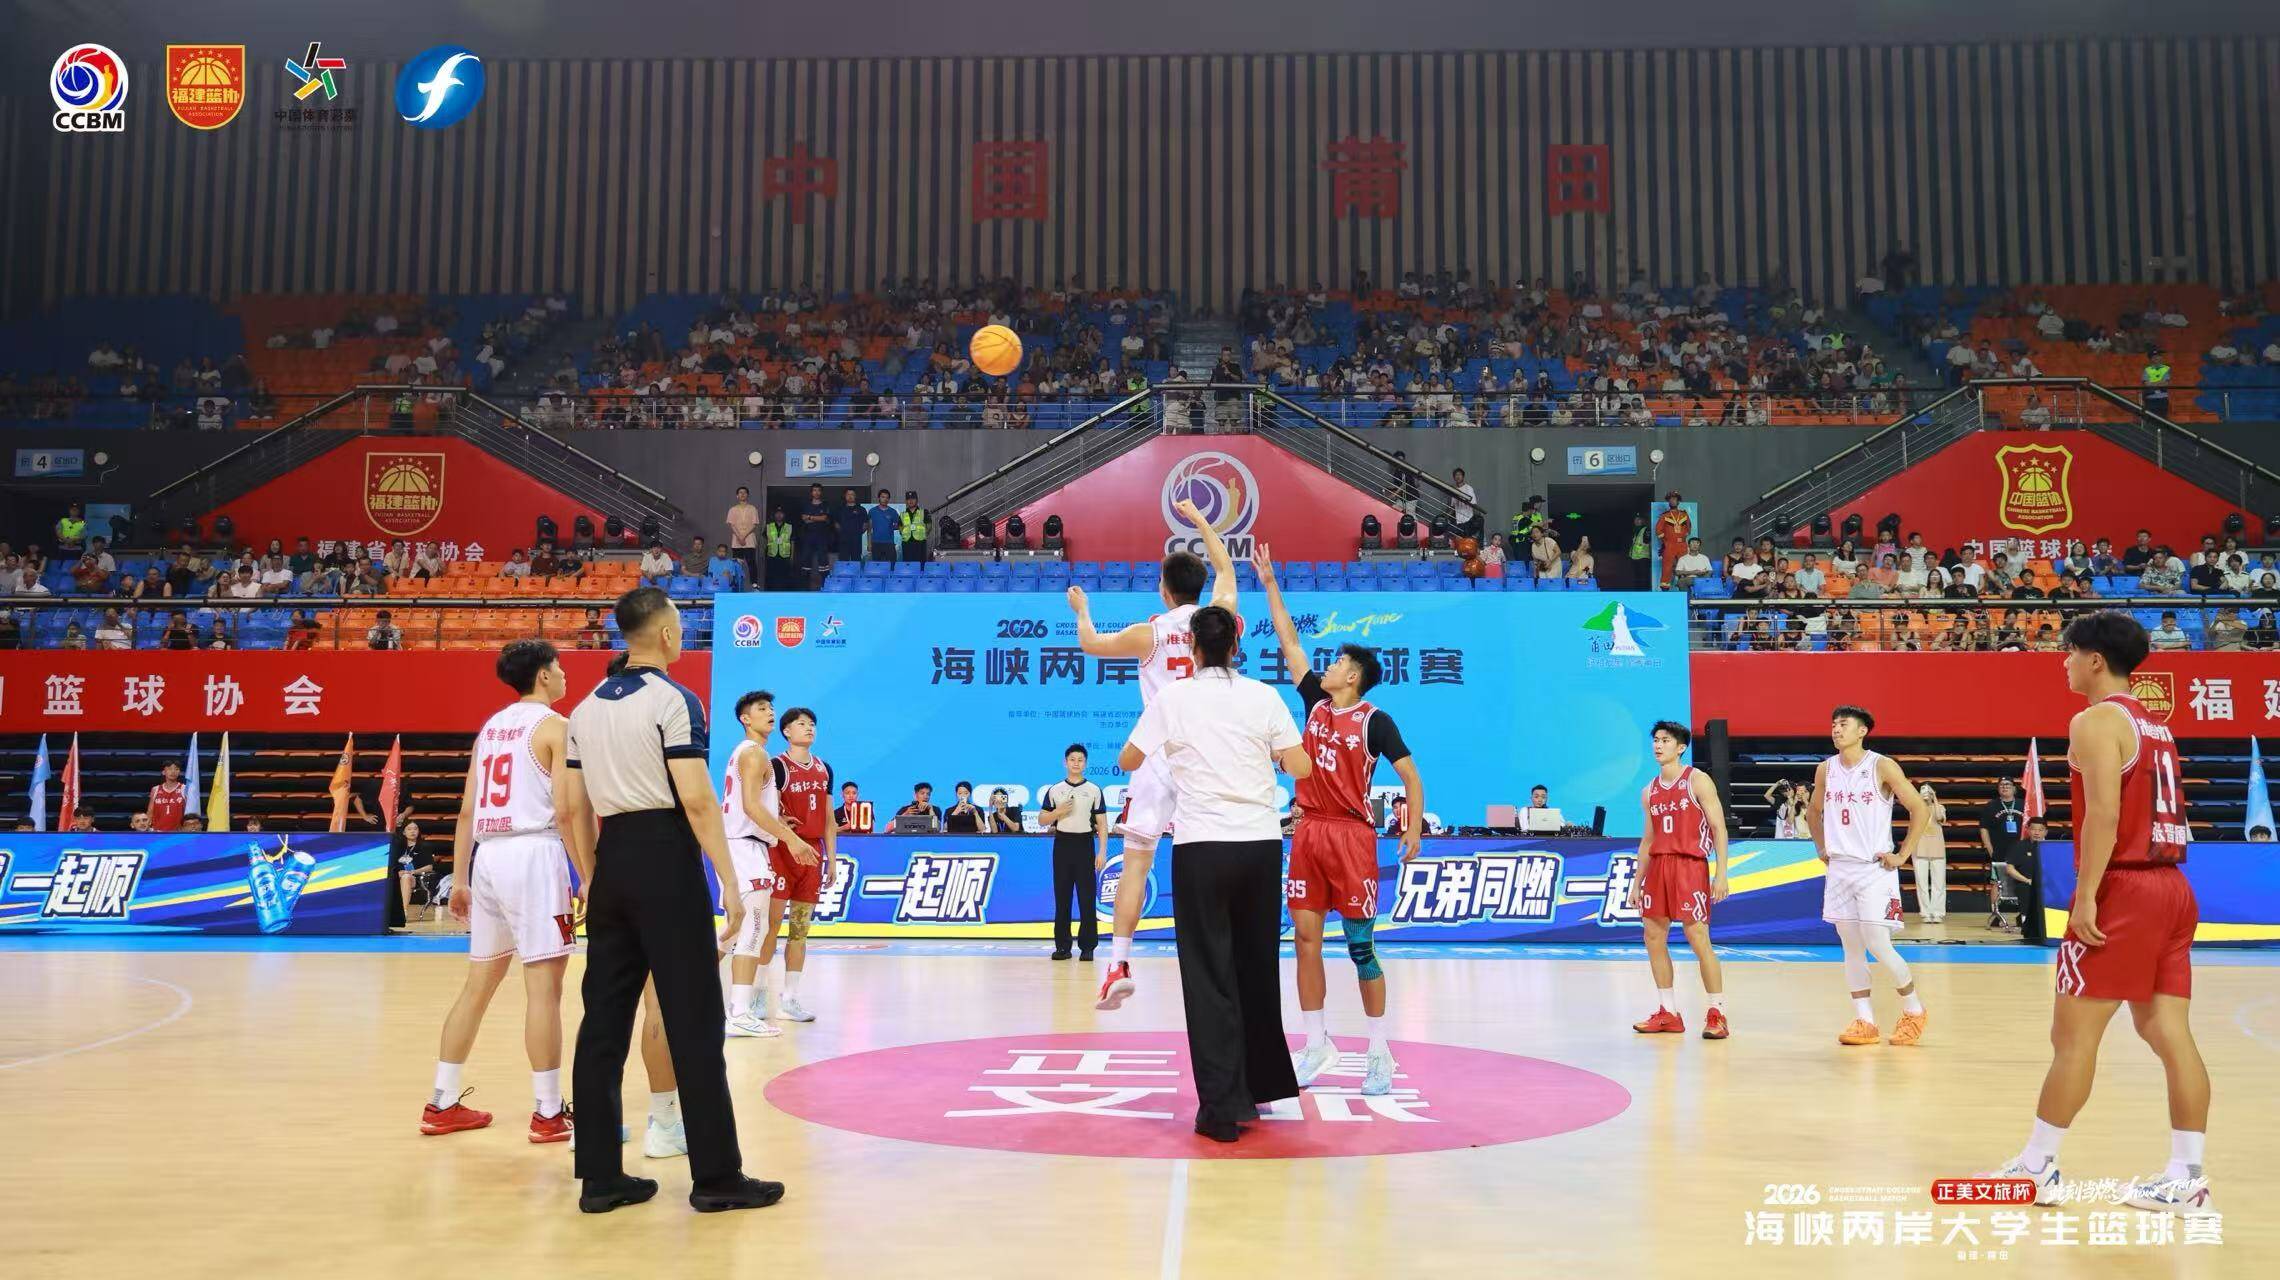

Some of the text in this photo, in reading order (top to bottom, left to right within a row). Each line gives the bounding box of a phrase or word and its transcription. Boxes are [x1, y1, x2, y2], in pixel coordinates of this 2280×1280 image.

[37, 455, 47, 469] 4
[807, 455, 817, 469] 5
[1590, 453, 1600, 467] 6
[369, 495, 439, 510] 福建篮协
[2009, 491, 2063, 507] 中国篮协
[1168, 537, 1251, 558] CCM
[996, 619, 1048, 639] 2026
[0, 674, 324, 716] 篮球协会
[1316, 744, 1337, 772] 35
[480, 752, 513, 808] 19
[2154, 750, 2176, 814] 11
[166, 805, 171, 814] 1
[809, 794, 817, 811] 8
[1663, 815, 1674, 834] 0
[1841, 808, 1851, 825] 8
[12, 853, 139, 914] 一起顺
[777, 876, 786, 891] 8
[864, 857, 994, 920] 一起顺
[1288, 880, 1306, 898] 35
[1396, 855, 1553, 920] 兄弟同燃
[1643, 894, 1651, 909] 0
